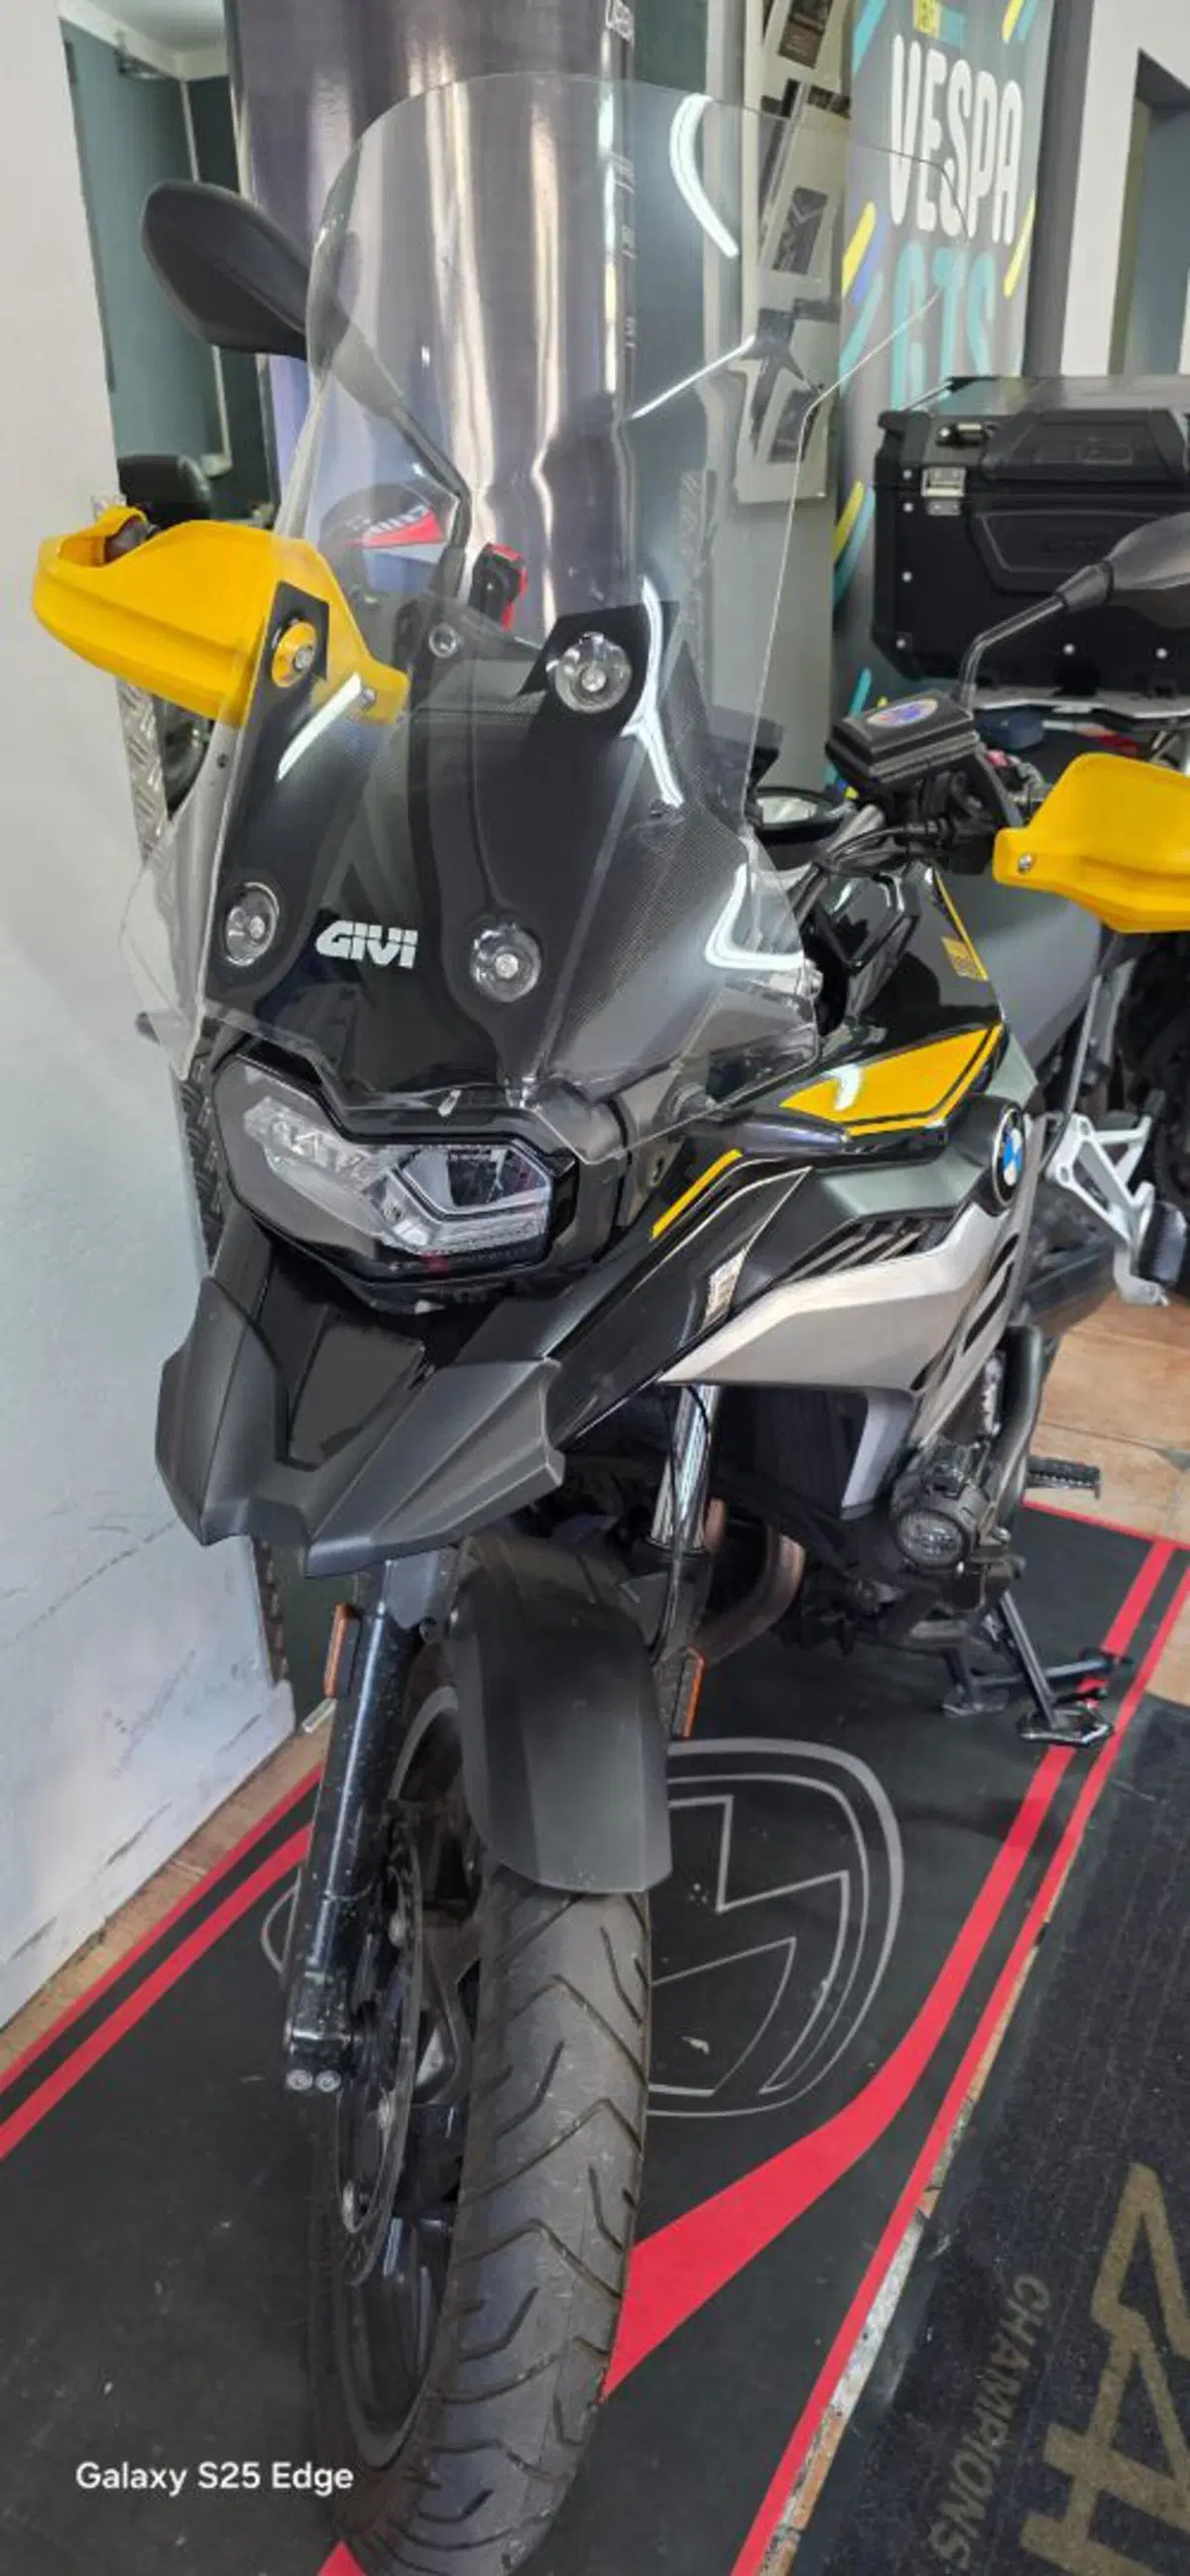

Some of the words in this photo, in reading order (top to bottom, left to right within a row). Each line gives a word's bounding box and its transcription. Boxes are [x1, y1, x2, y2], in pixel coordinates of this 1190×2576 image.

[891, 34, 1022, 245] VESPA
[314, 920, 418, 969] GIVI
[928, 2273, 1050, 2569] CHAMPIONS
